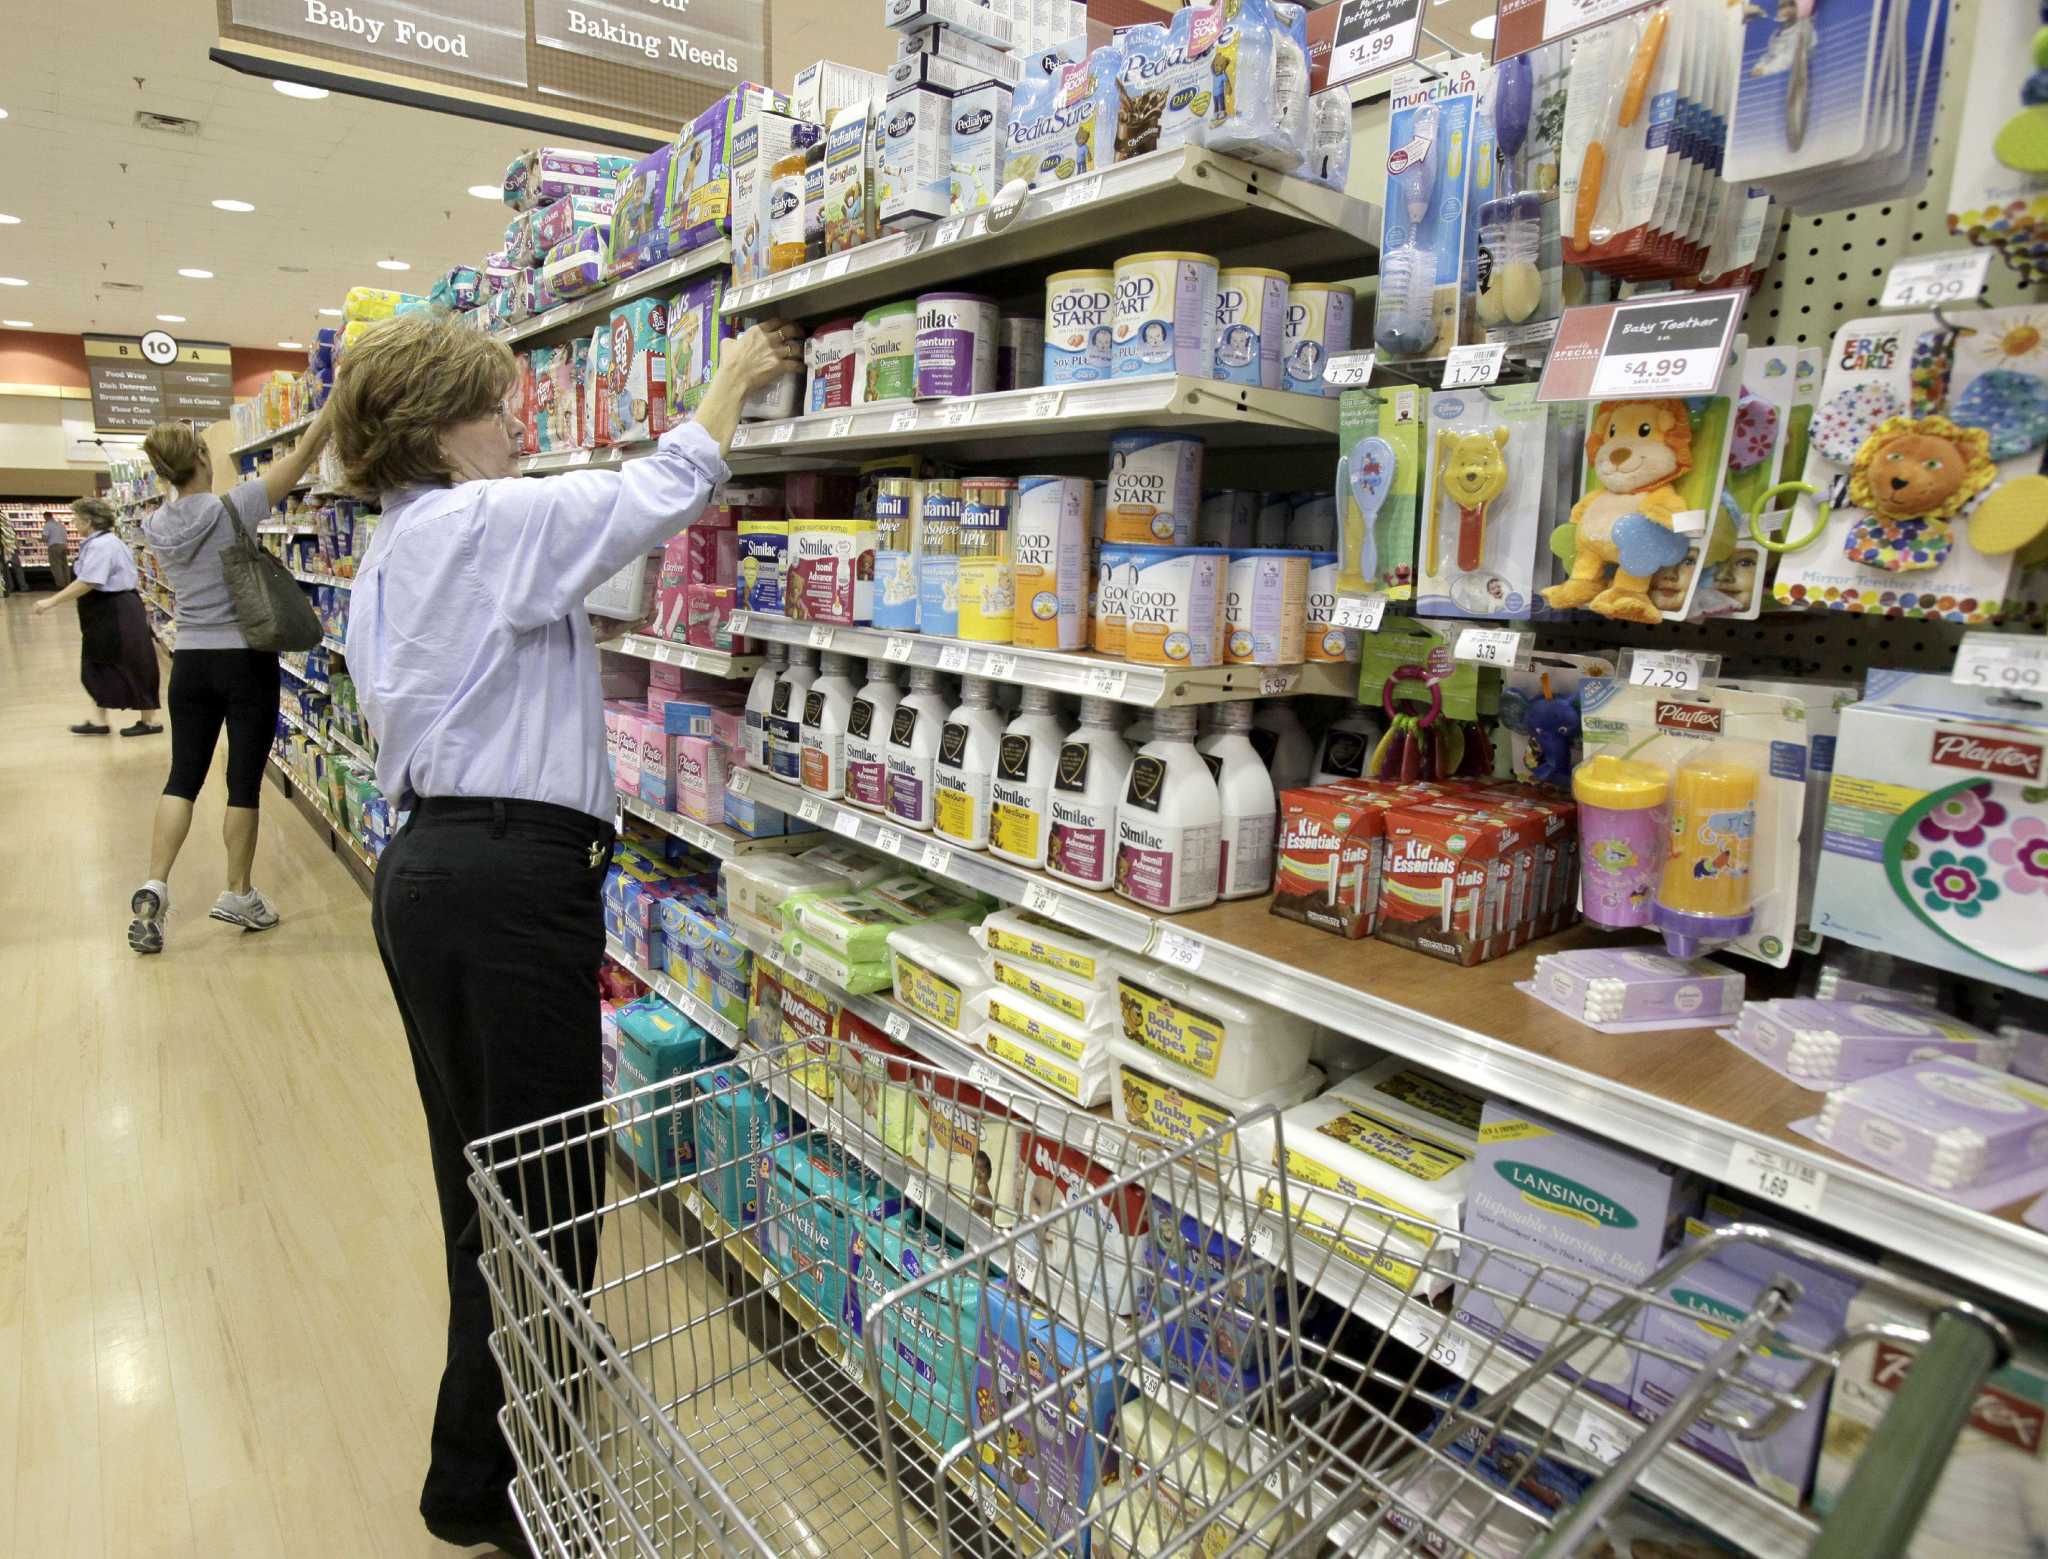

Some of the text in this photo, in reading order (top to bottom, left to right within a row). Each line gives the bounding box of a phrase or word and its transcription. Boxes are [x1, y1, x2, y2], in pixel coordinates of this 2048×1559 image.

[304, 0, 469, 58] Baby Food
[1363, 11, 1391, 29] Brush
[567, 10, 738, 74] Baking Needs
[1349, 34, 1394, 62] $1.99
[1392, 71, 1476, 112] munchkin
[887, 112, 916, 134] Pedialyte
[956, 112, 992, 130] Pedialyte
[1006, 100, 1097, 148] PediaSure
[827, 123, 865, 154] Pedialyte
[1115, 278, 1154, 301] OOD
[1051, 292, 1111, 312] GOOD
[1115, 296, 1151, 317] TART
[1052, 309, 1107, 328] START
[1622, 317, 1719, 335] Baby Teether
[119, 346, 128, 355] B
[148, 341, 171, 354] 10
[191, 350, 200, 360] A
[815, 348, 841, 366] Similac
[870, 340, 901, 356] Similac
[1554, 347, 1600, 359] SPECIAL
[1624, 358, 1688, 378] $4.99
[1841, 353, 1894, 371] CARLE
[1330, 367, 1364, 384] 1.79
[1452, 364, 1491, 384] 1.79
[1117, 473, 1164, 489] GOOD
[1113, 489, 1166, 504] START
[748, 540, 777, 557] Similac
[799, 537, 833, 556] Similac
[1016, 534, 1050, 549] OOD
[1016, 549, 1053, 564] TART
[808, 572, 833, 583] Advance
[1101, 600, 1126, 615] STA
[1132, 590, 1176, 607] GOOD
[1130, 605, 1178, 623] START
[1339, 610, 1374, 628] 3.19
[1475, 642, 1495, 660] 3.79
[1640, 668, 1688, 689] 7.29
[1658, 704, 1720, 729] Playtex
[847, 744, 877, 763] Similac
[1935, 735, 2038, 775] Playtex
[678, 755, 701, 774] Playtex
[887, 754, 916, 776] Similac
[935, 769, 967, 792] Similac
[992, 783, 1031, 808] Similac
[1052, 801, 1095, 828] Similac
[1119, 821, 1163, 850] Similac
[1298, 817, 1321, 837] Kid
[1065, 837, 1096, 851] Advance
[1287, 832, 1341, 850] Essentials
[1407, 839, 1432, 859] Kid
[1342, 847, 1368, 862] tials
[1132, 858, 1163, 875] Advance
[1393, 856, 1456, 874] Essentials
[1456, 870, 1485, 886] tials
[624, 911, 644, 939] TAMPAX
[1169, 946, 1193, 964] 7.99
[780, 988, 826, 1034] HUGGIES
[1148, 1011, 1184, 1041] Baby
[1145, 1023, 1186, 1054] Wipes
[1154, 1099, 1193, 1128] Baby
[1151, 1110, 1196, 1141] Wipes
[1360, 1135, 1409, 1161] Wipes
[1370, 1131, 1414, 1154] Baby
[1513, 1168, 1616, 1221] LANSINOH
[1759, 1172, 1789, 1198] 1.69
[1476, 1192, 1648, 1277] Disposable Nursing Pads
[1375, 1255, 1393, 1272] 80
